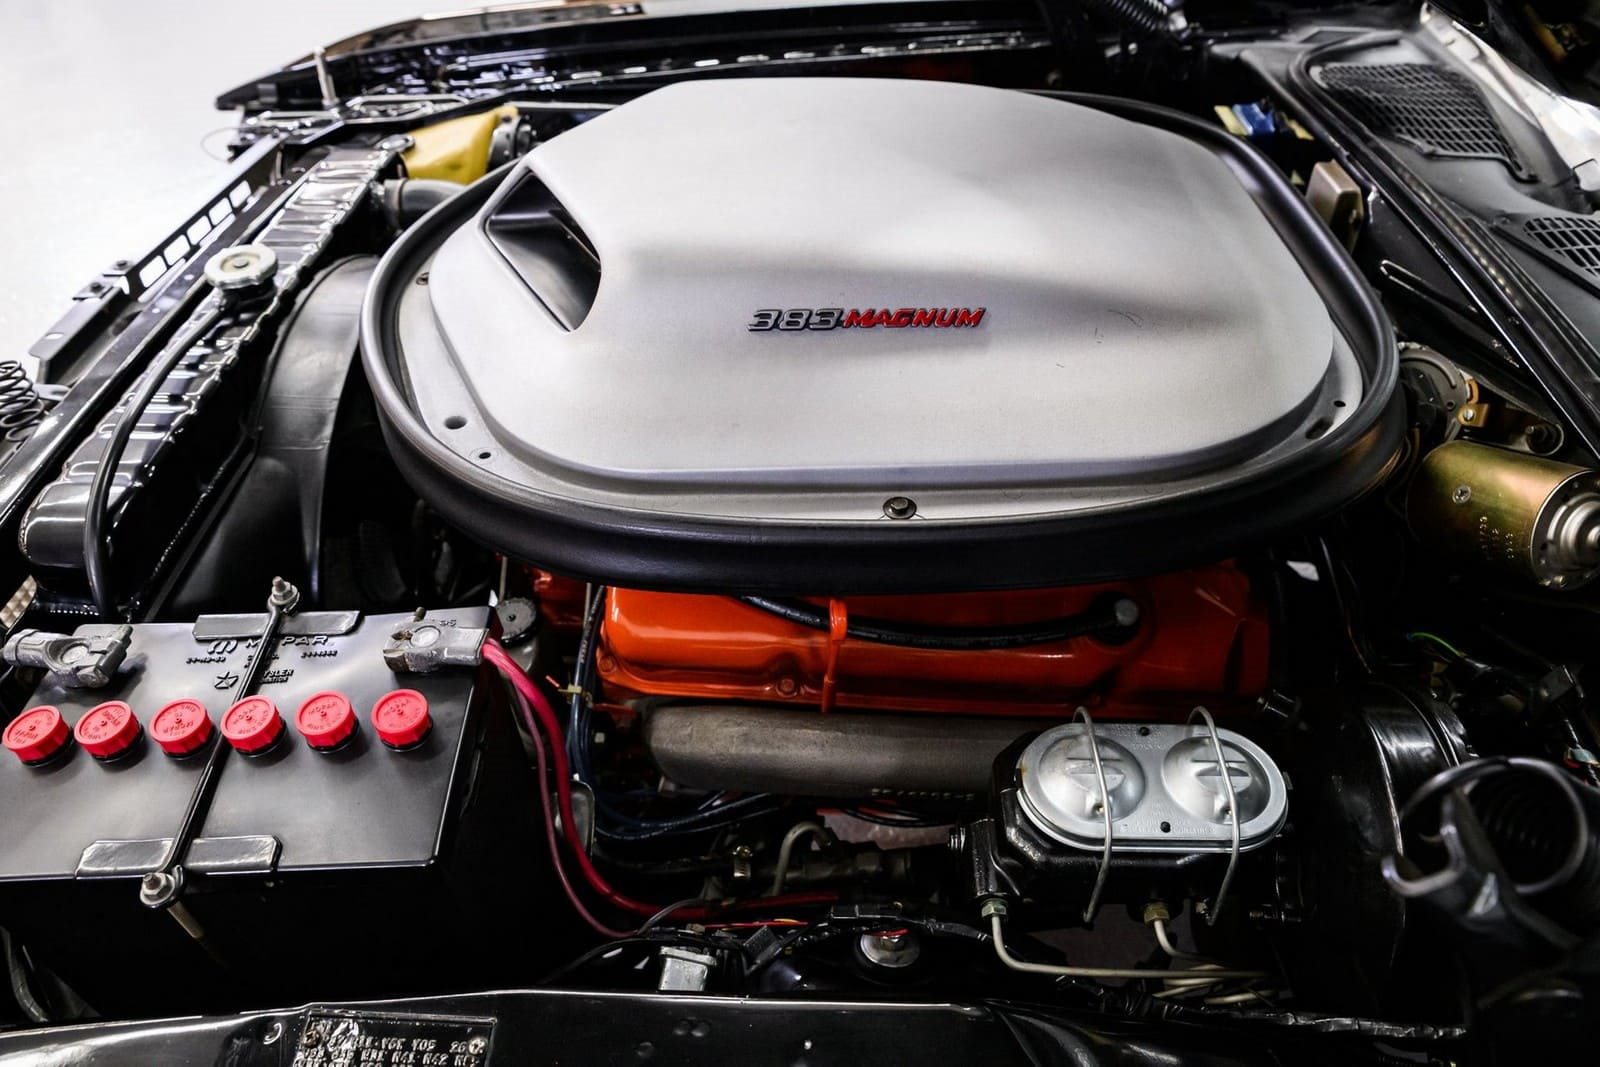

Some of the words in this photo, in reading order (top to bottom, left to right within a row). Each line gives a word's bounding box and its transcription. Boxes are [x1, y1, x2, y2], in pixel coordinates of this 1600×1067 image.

[748, 307, 844, 331] 383
[843, 306, 987, 329] MAGNUM
[245, 635, 329, 649] MPAR
